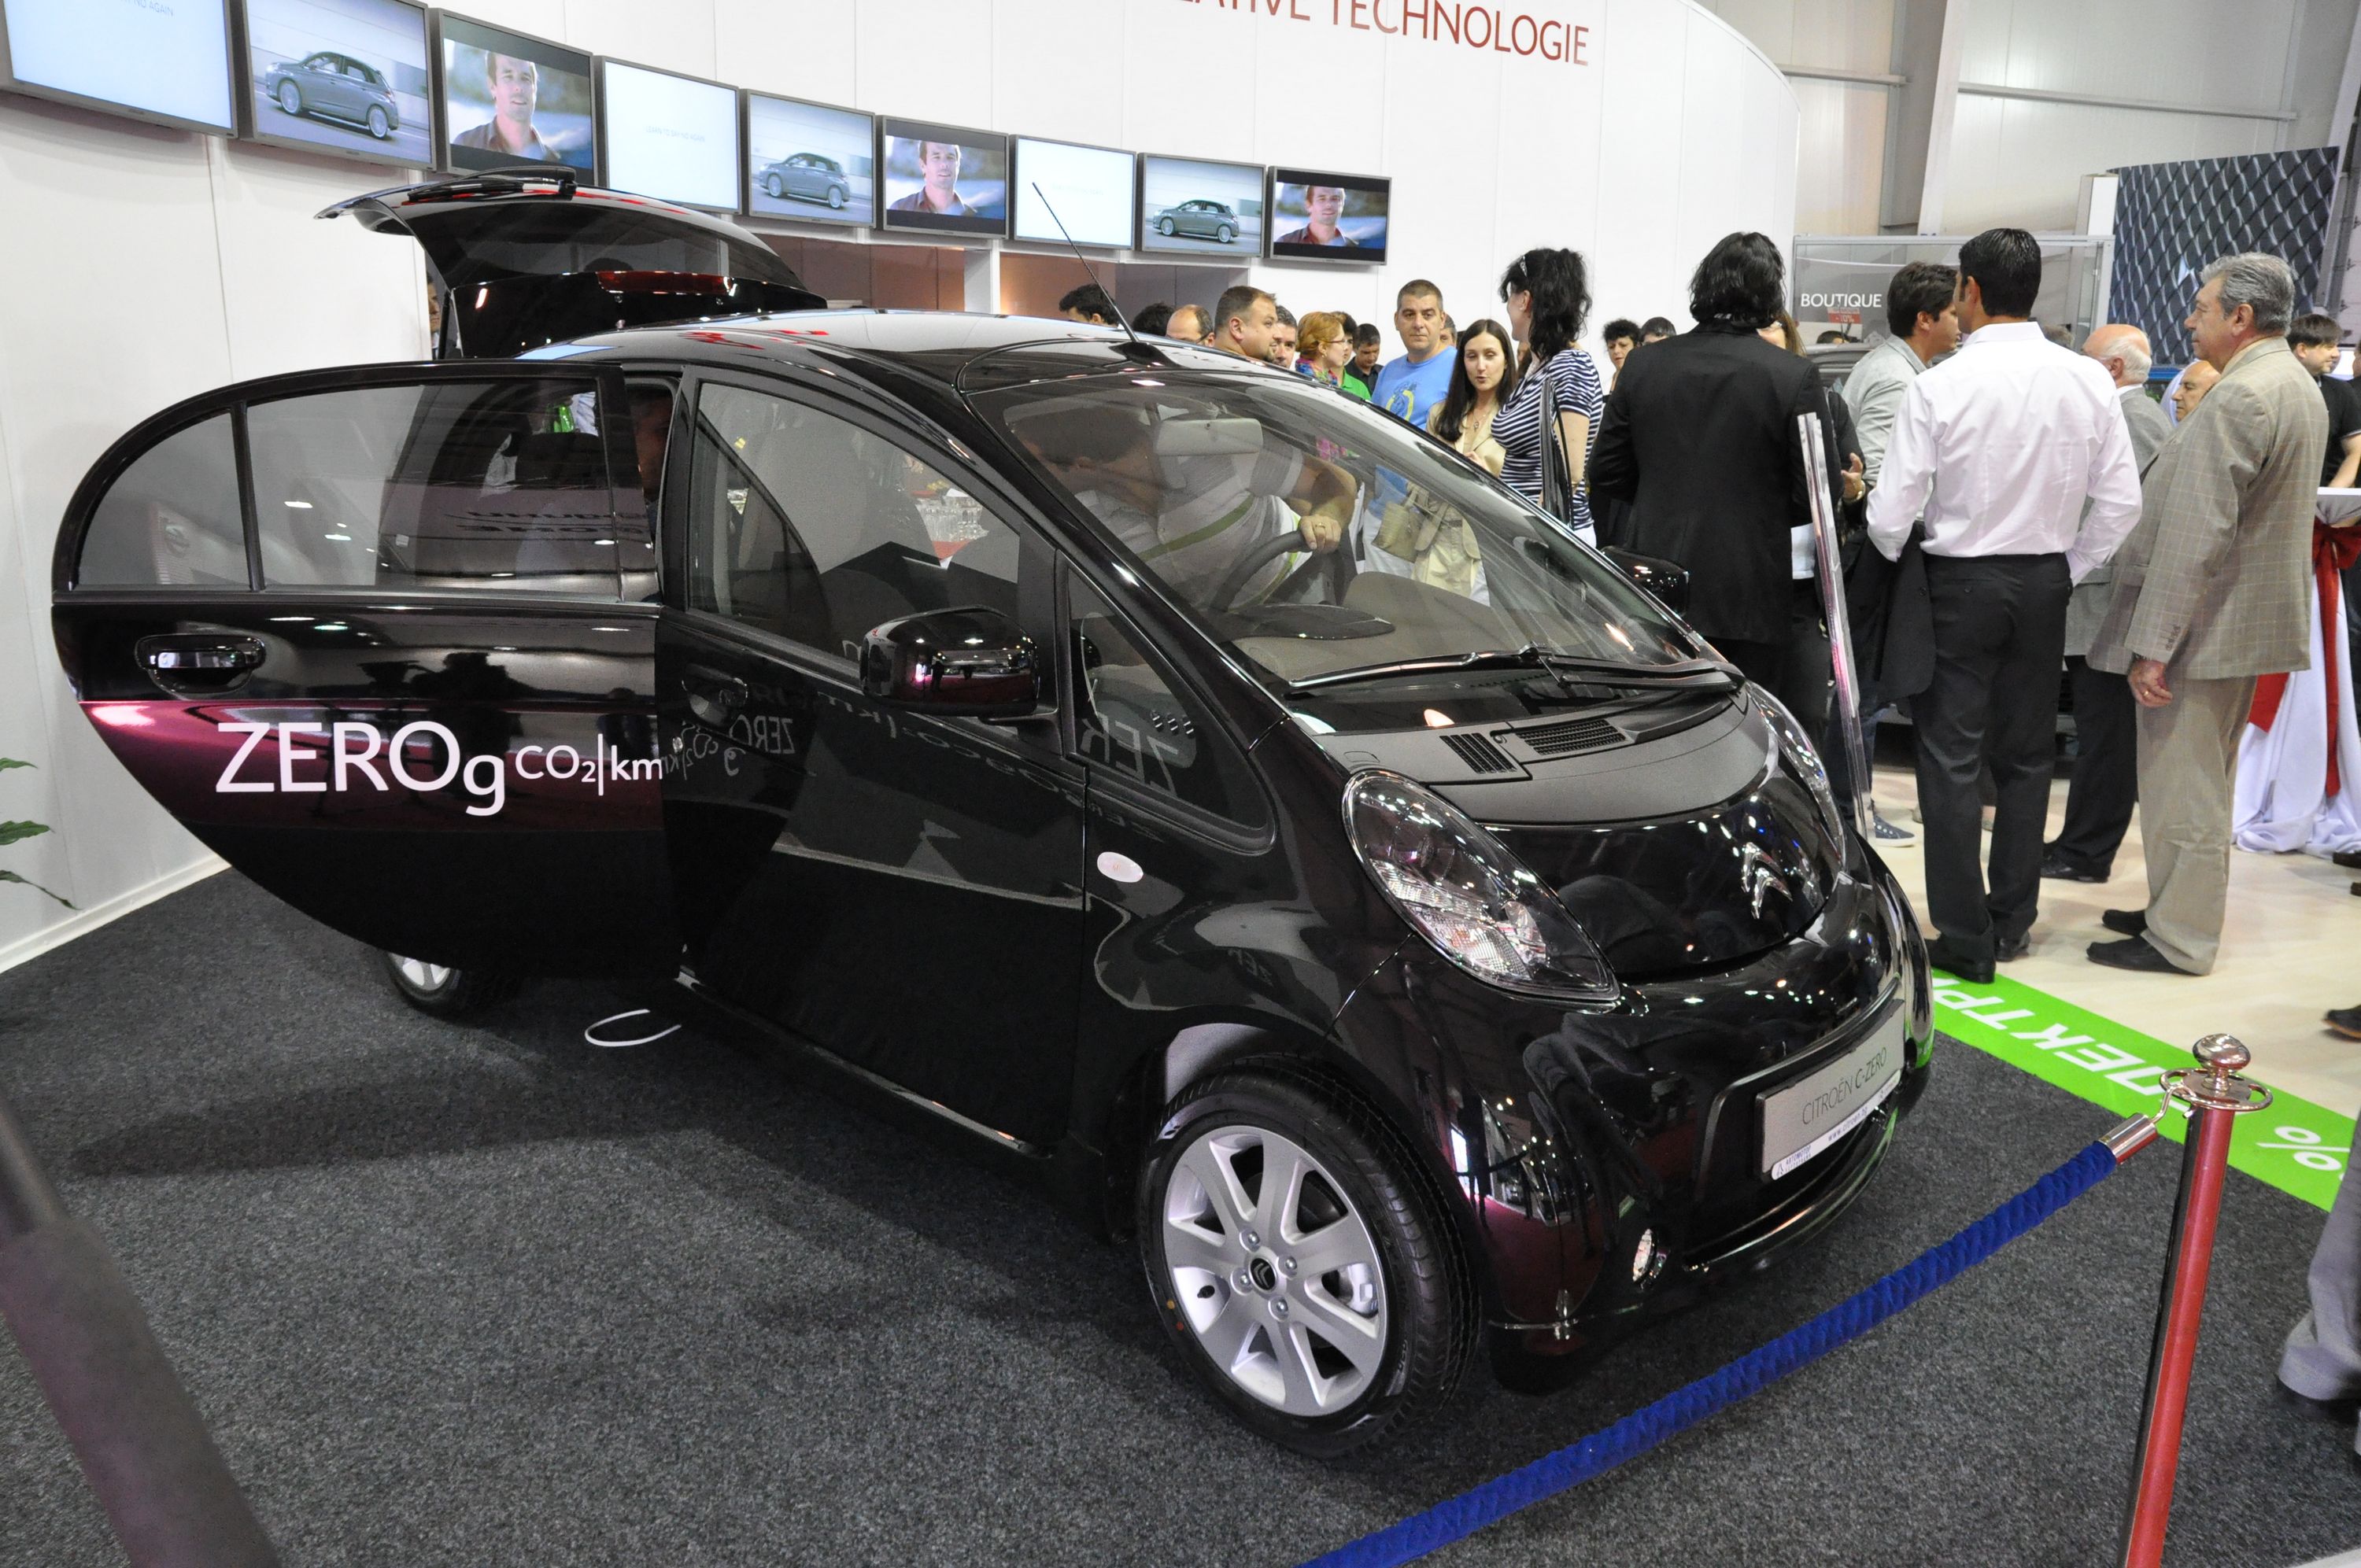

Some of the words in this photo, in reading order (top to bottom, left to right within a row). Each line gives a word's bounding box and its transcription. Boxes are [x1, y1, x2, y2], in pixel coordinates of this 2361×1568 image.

[150, 2, 174, 17] AGAIN
[1800, 293, 1883, 308] BOUTIQUE
[1801, 1078, 1853, 1125] CITROËN
[1854, 1046, 1888, 1090] C-ZERO
